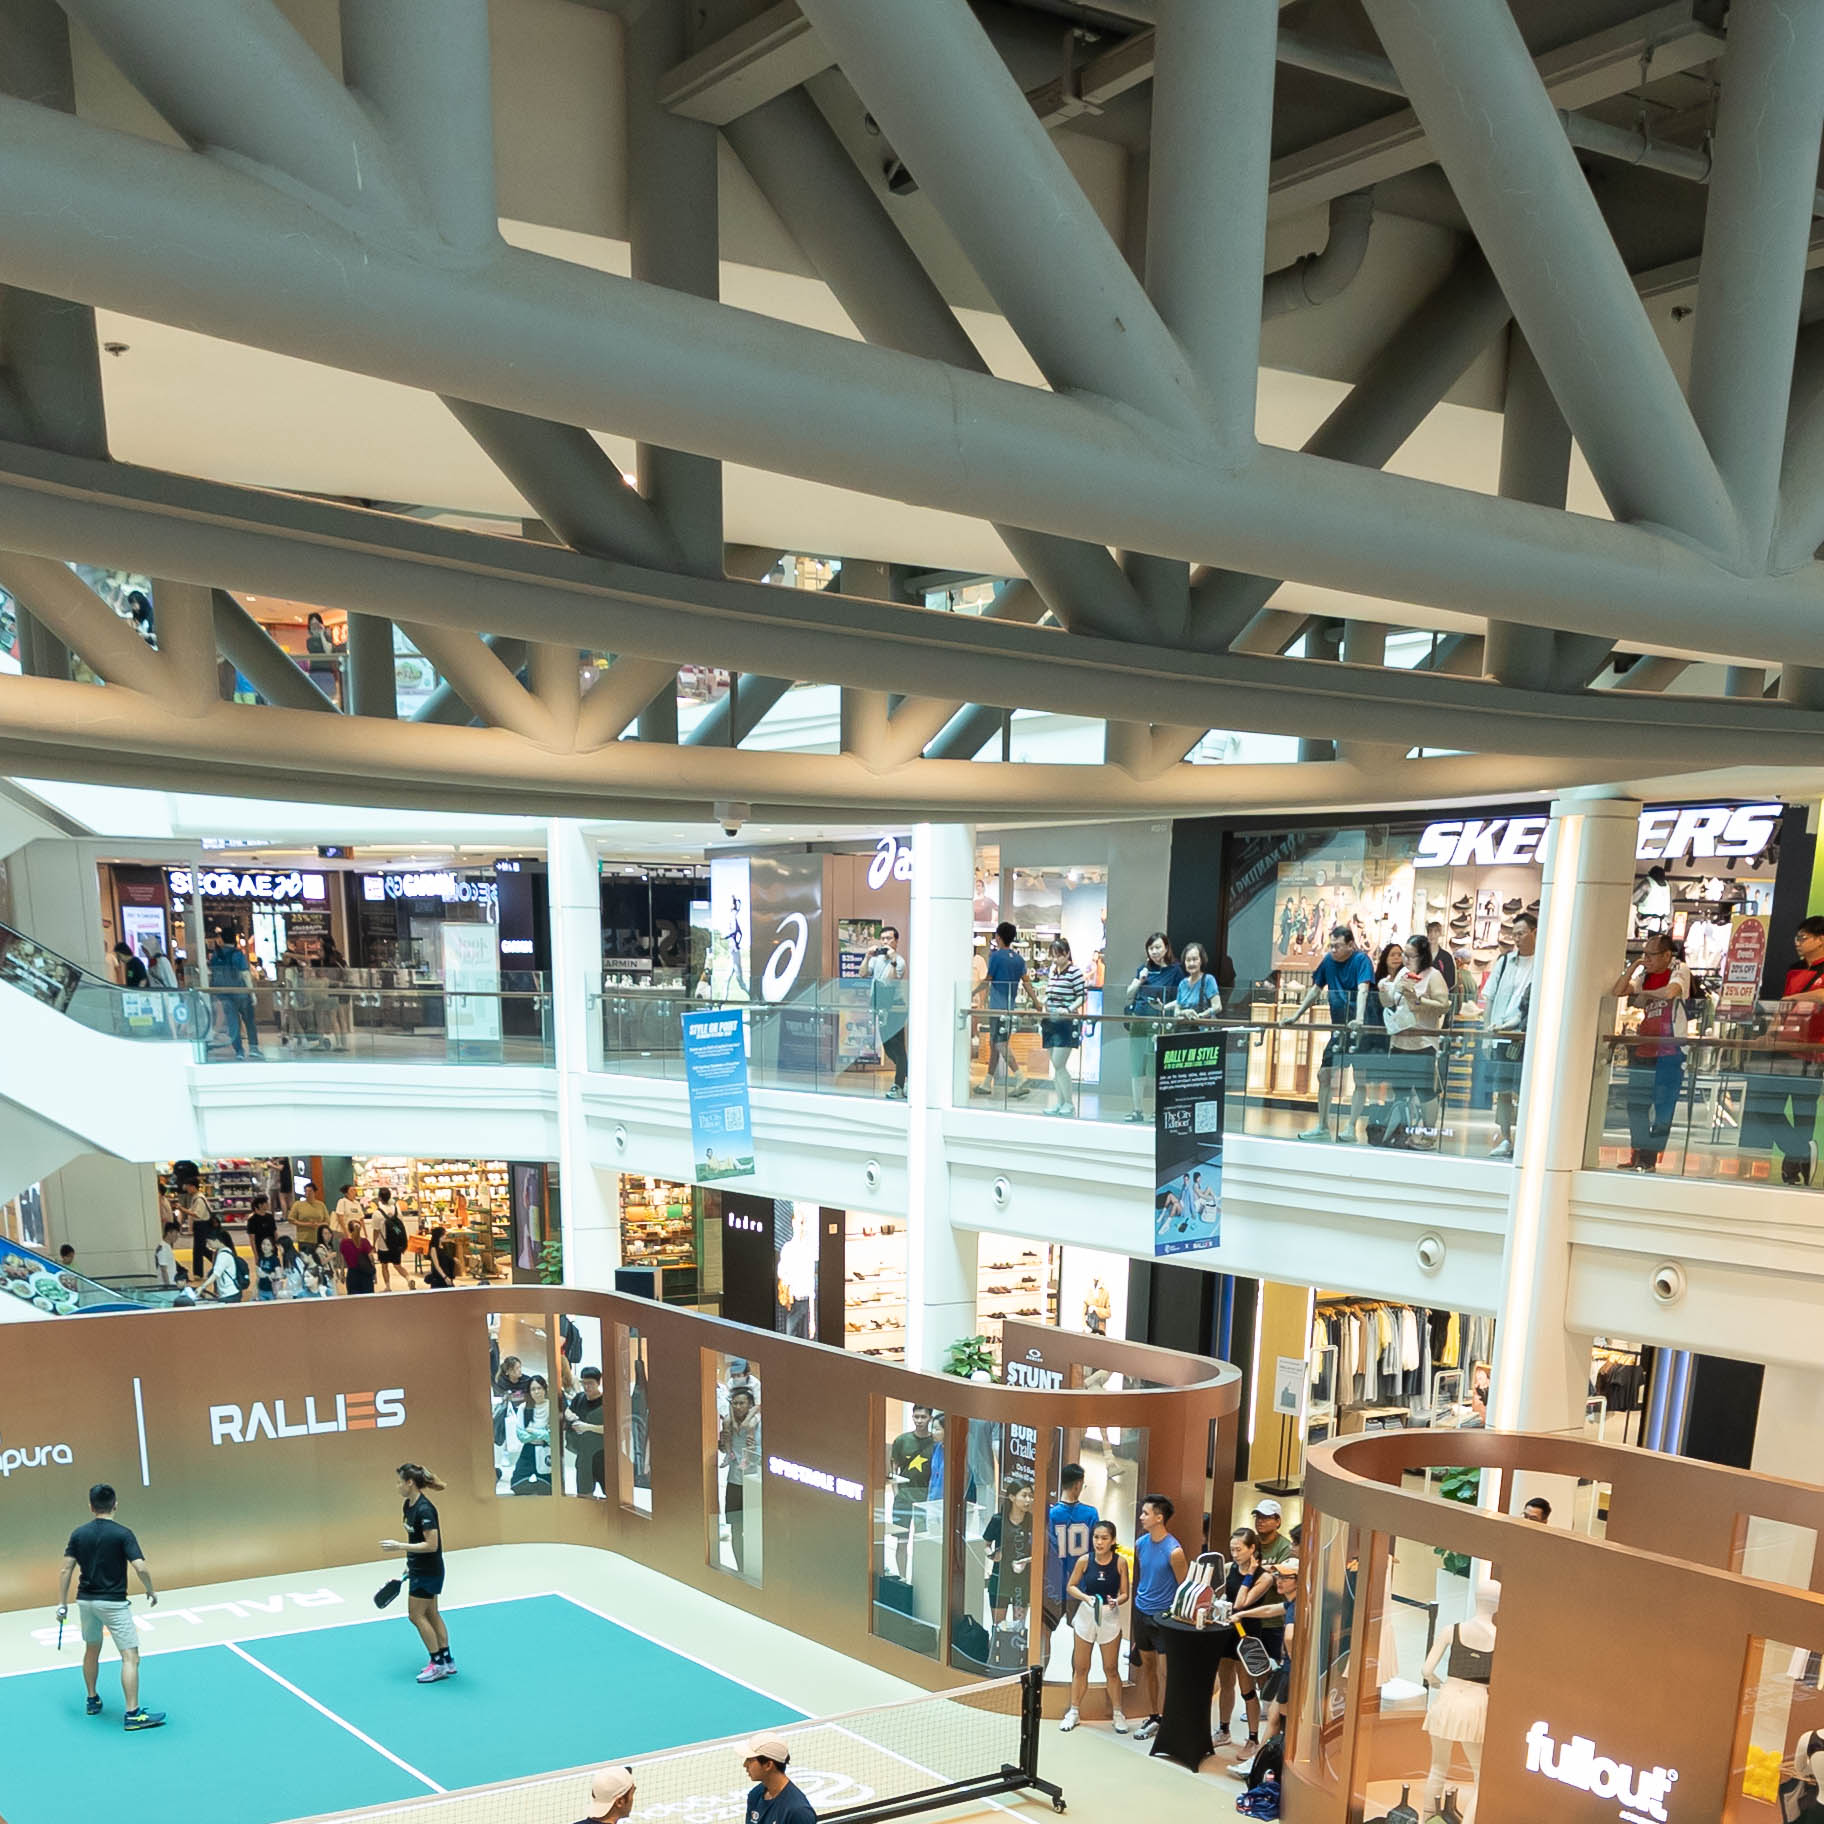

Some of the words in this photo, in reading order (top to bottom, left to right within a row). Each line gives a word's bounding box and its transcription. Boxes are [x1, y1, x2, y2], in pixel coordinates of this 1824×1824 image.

[1412, 805, 1784, 868] SKEERS
[605, 960, 639, 968] ARMIN
[1164, 1049, 1187, 1064] RALLY
[1197, 1046, 1220, 1060] STYLE
[1007, 1361, 1063, 1390] STUNT
[210, 1388, 406, 1446] RALLIES
[1010, 1438, 1036, 1462] Challe
[1055, 1523, 1089, 1558] 10
[30, 1588, 344, 1646] RALLIS
[1525, 1721, 1672, 1823] fullout
